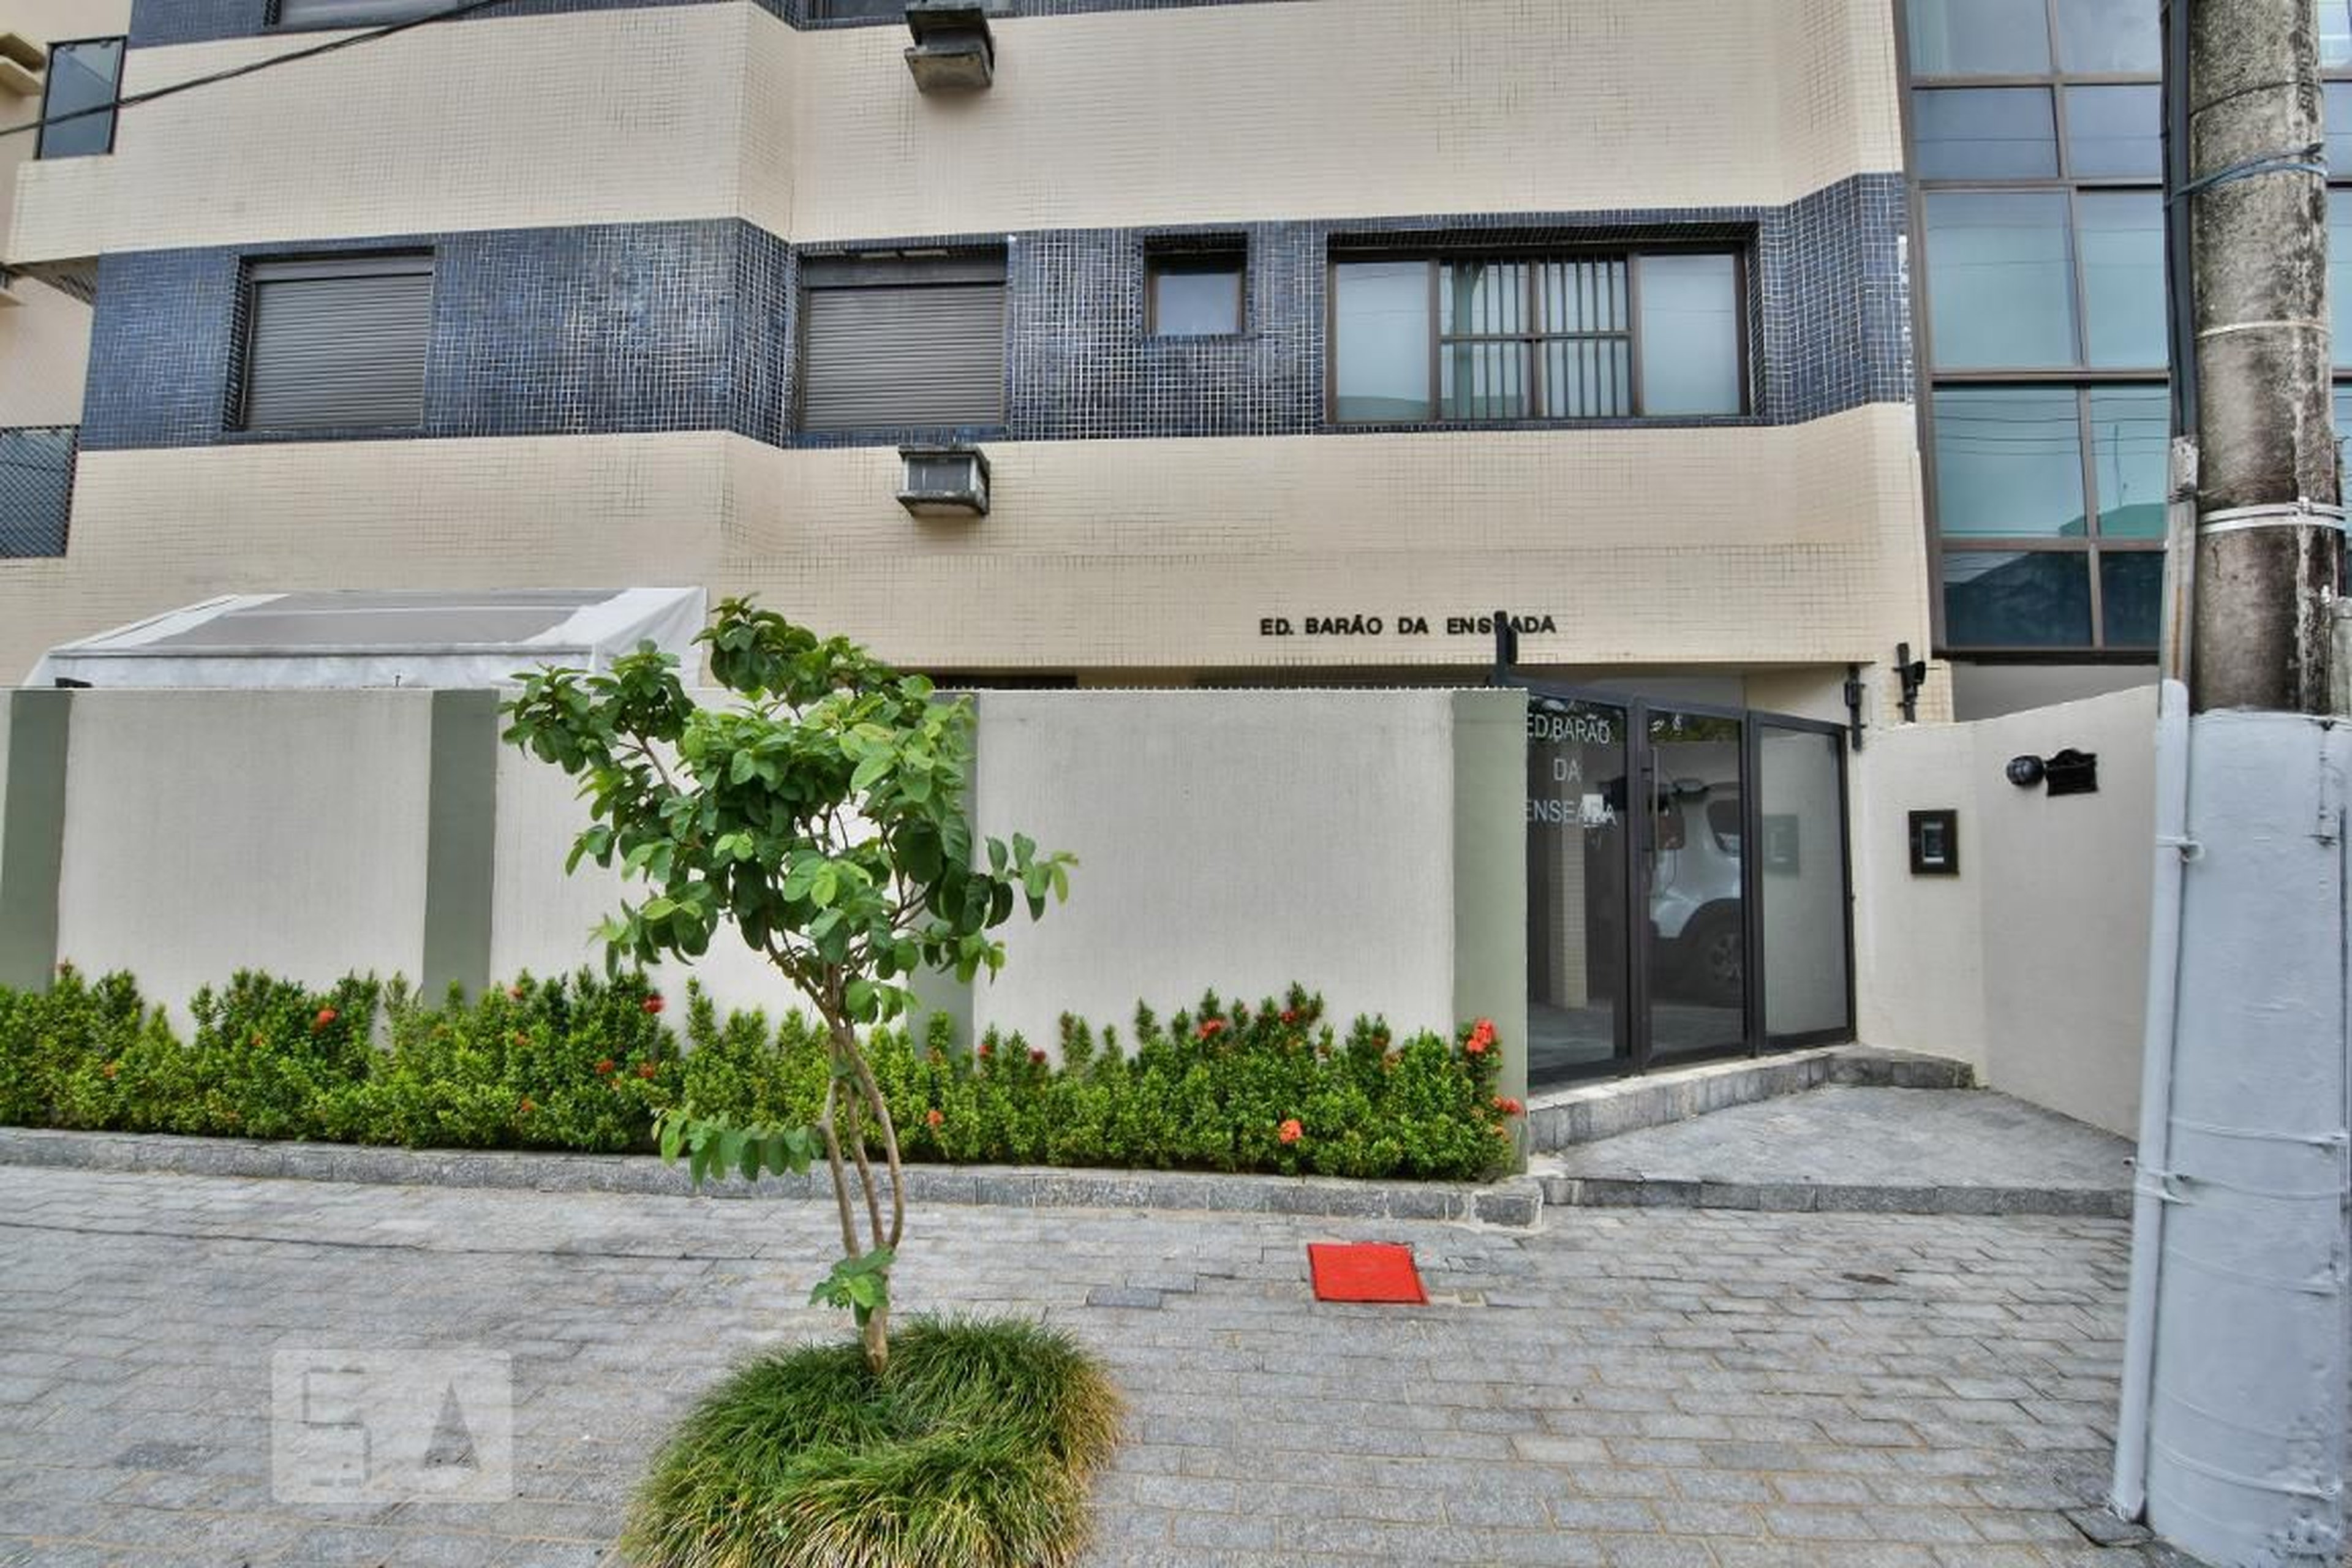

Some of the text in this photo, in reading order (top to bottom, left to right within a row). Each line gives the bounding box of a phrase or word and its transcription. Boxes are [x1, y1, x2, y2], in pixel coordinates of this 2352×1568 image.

[1260, 614, 1556, 636] ED. BARÃO DA ENSADA
[1553, 758, 1583, 783] DA
